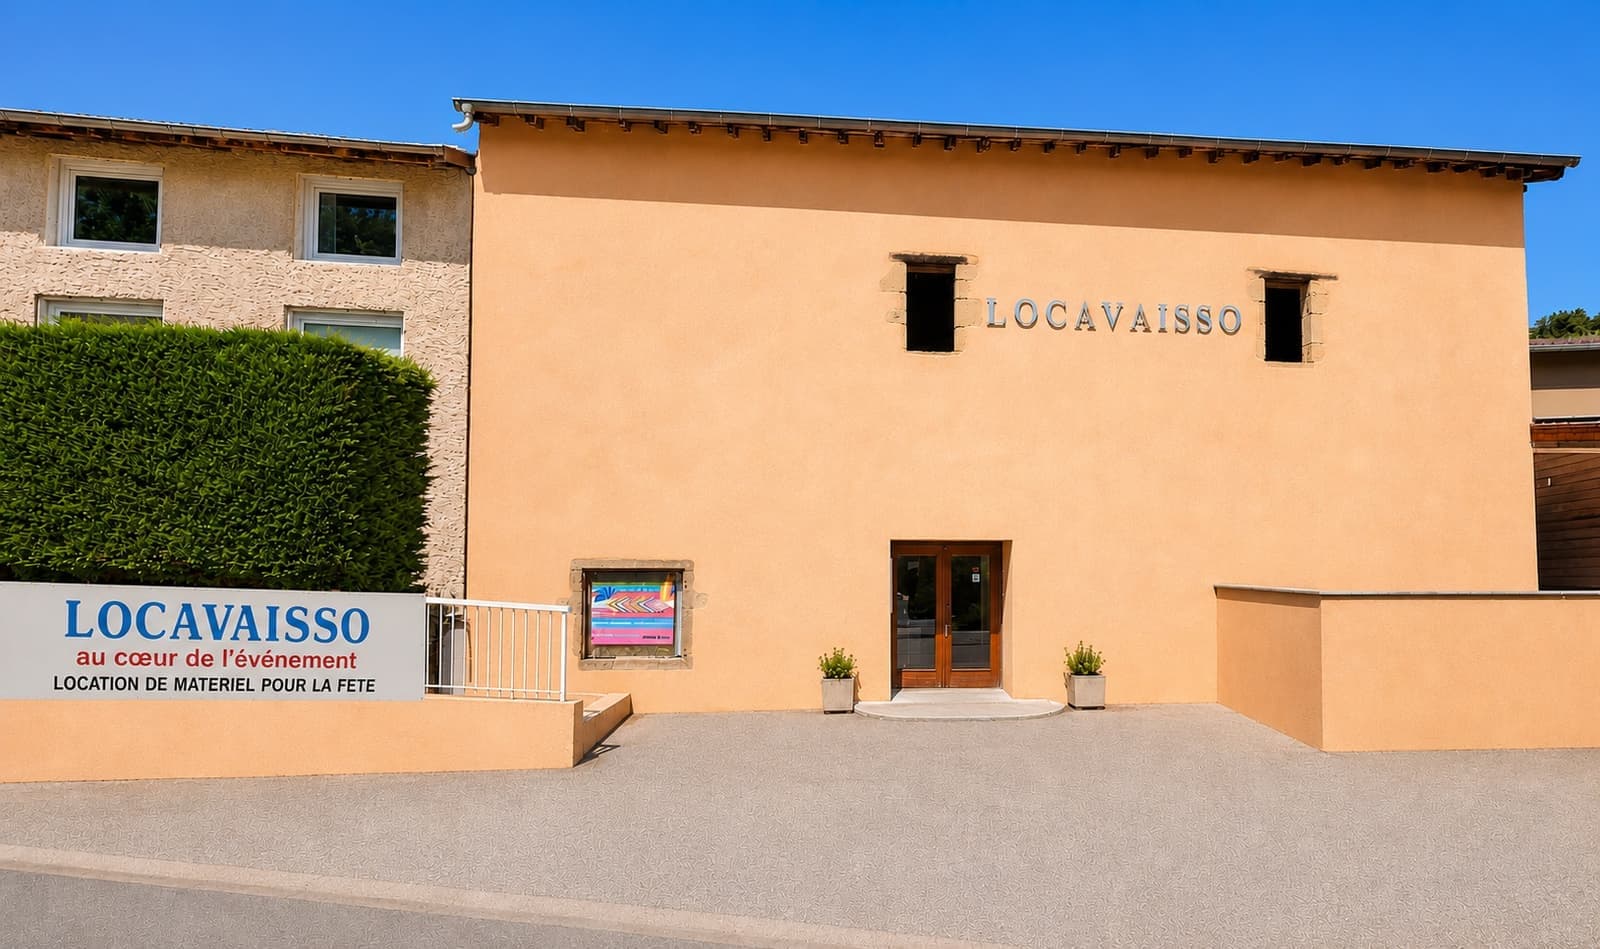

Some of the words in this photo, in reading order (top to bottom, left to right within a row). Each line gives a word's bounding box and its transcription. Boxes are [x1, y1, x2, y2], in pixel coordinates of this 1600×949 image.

[986, 298, 1242, 335] LOCAVAISSO
[65, 599, 370, 644] LOCAVAISSO
[76, 650, 105, 666] au
[114, 649, 178, 668] cœur
[186, 649, 215, 668] de
[54, 675, 139, 691] LOCATION
[146, 676, 168, 691] DE
[174, 677, 255, 692] MATERIEL
[262, 678, 306, 692] POUR
[312, 679, 332, 692] LA
[337, 679, 375, 693] FETE
